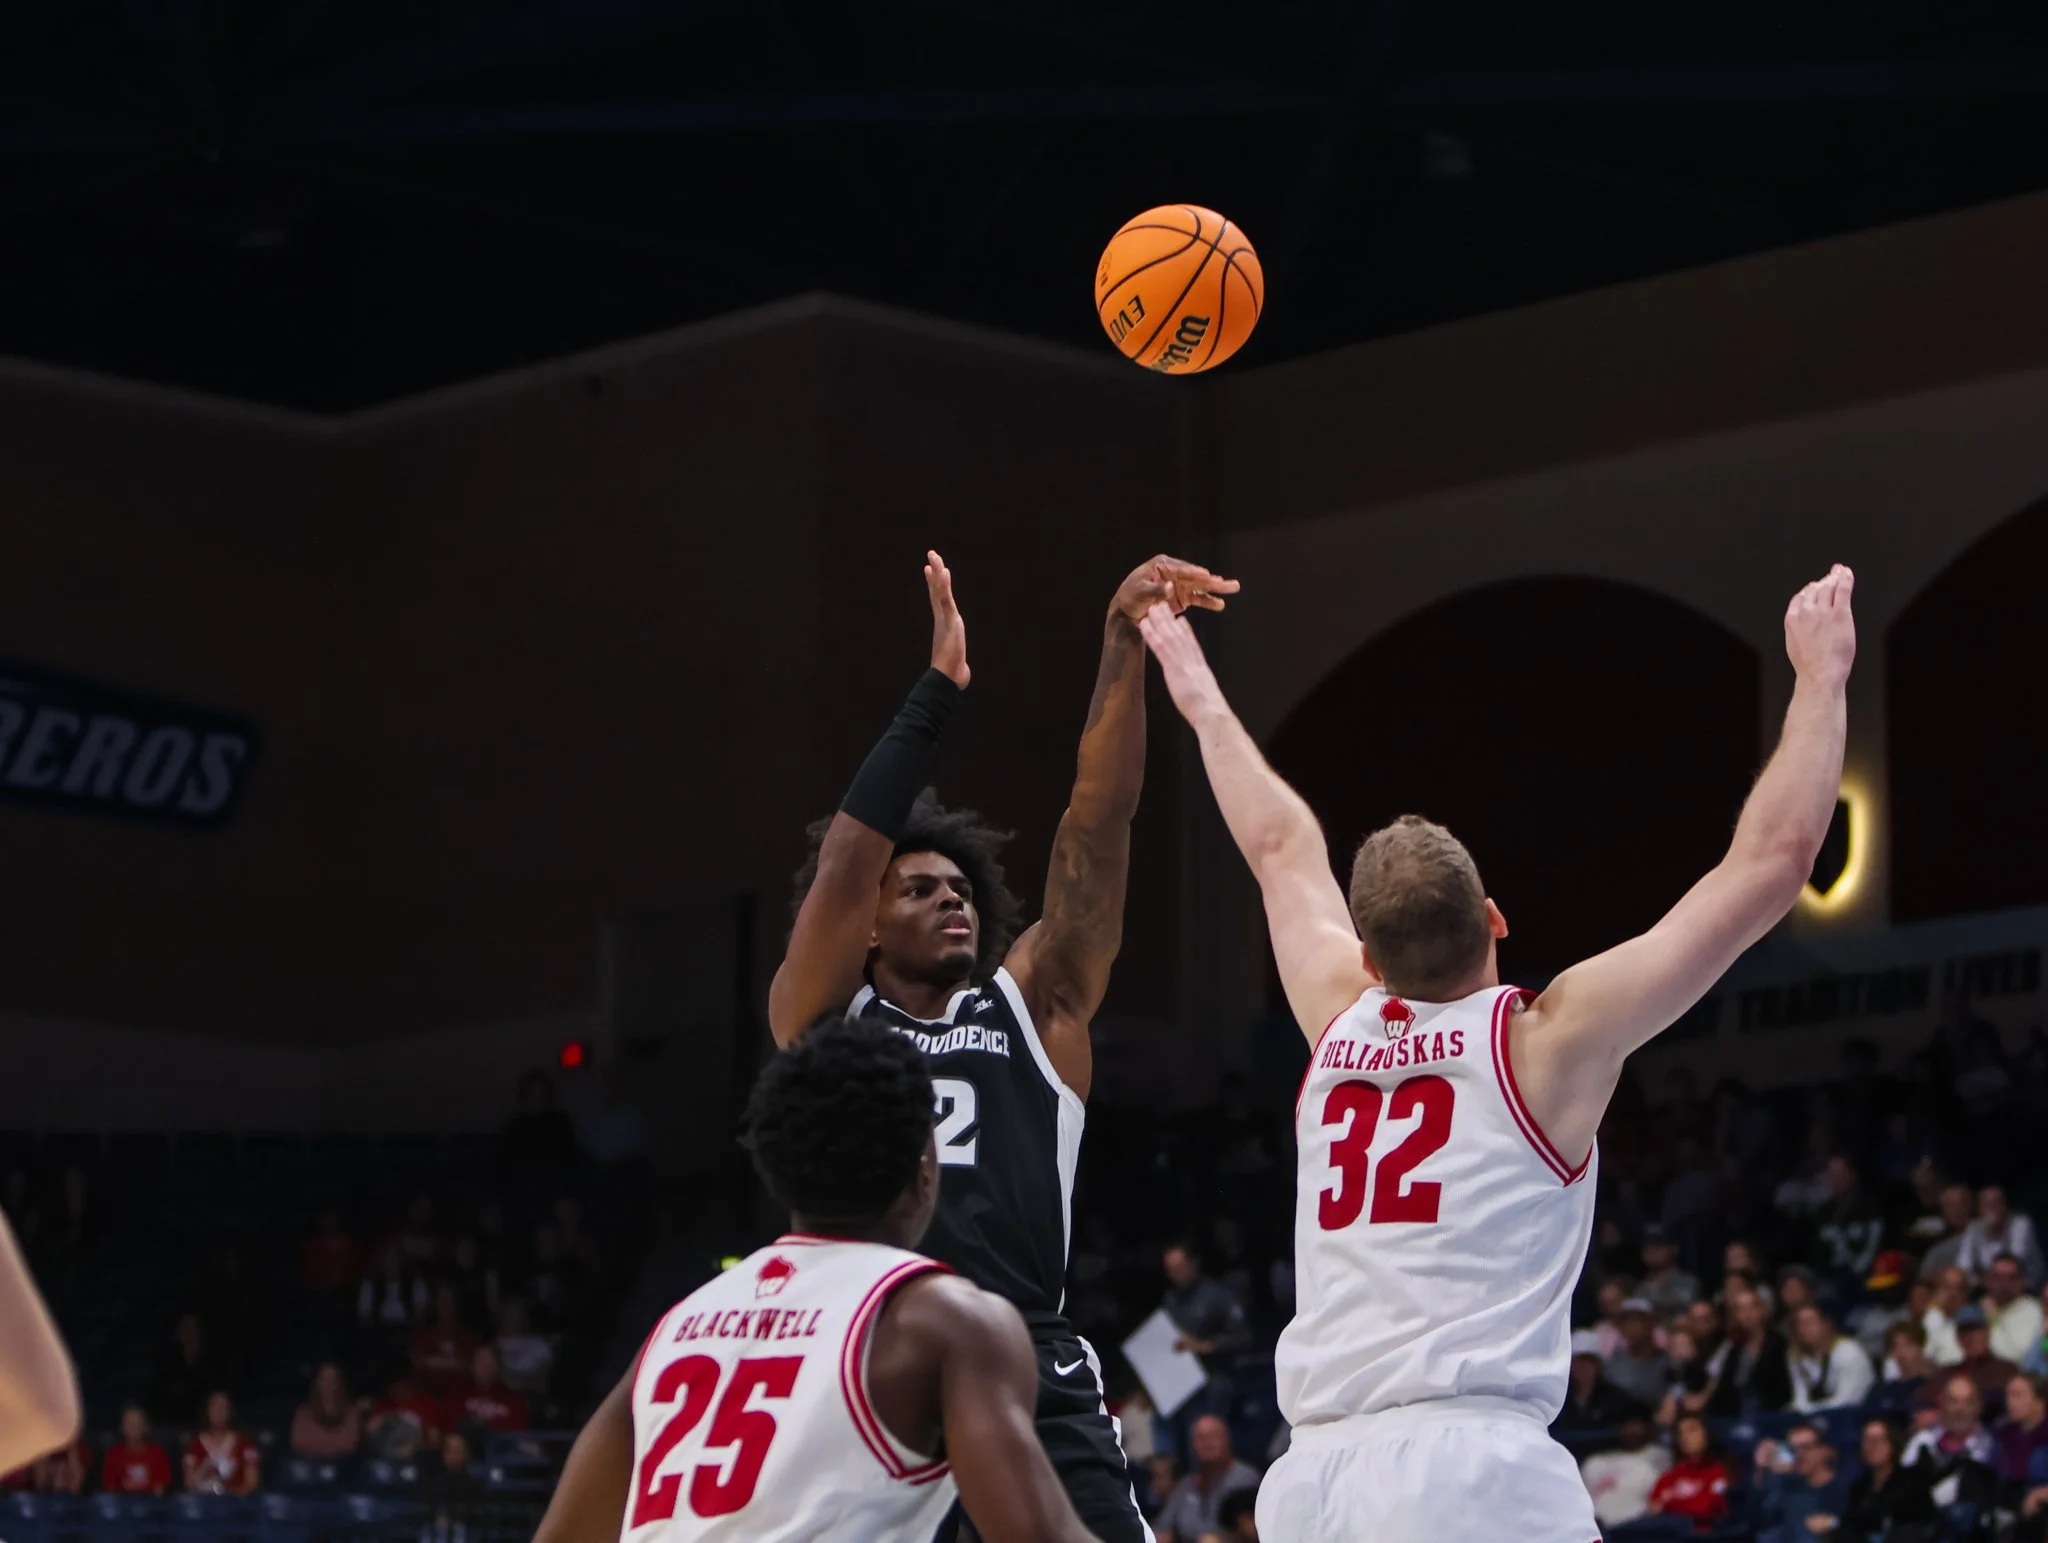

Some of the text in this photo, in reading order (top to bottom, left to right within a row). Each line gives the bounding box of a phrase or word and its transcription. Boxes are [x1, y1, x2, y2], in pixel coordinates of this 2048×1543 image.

[1319, 1030, 1465, 1072] BIELIAUSKAS
[1318, 1075, 1455, 1231] 32
[672, 1307, 824, 1343] BLACKWELL
[632, 1354, 805, 1529] 25
